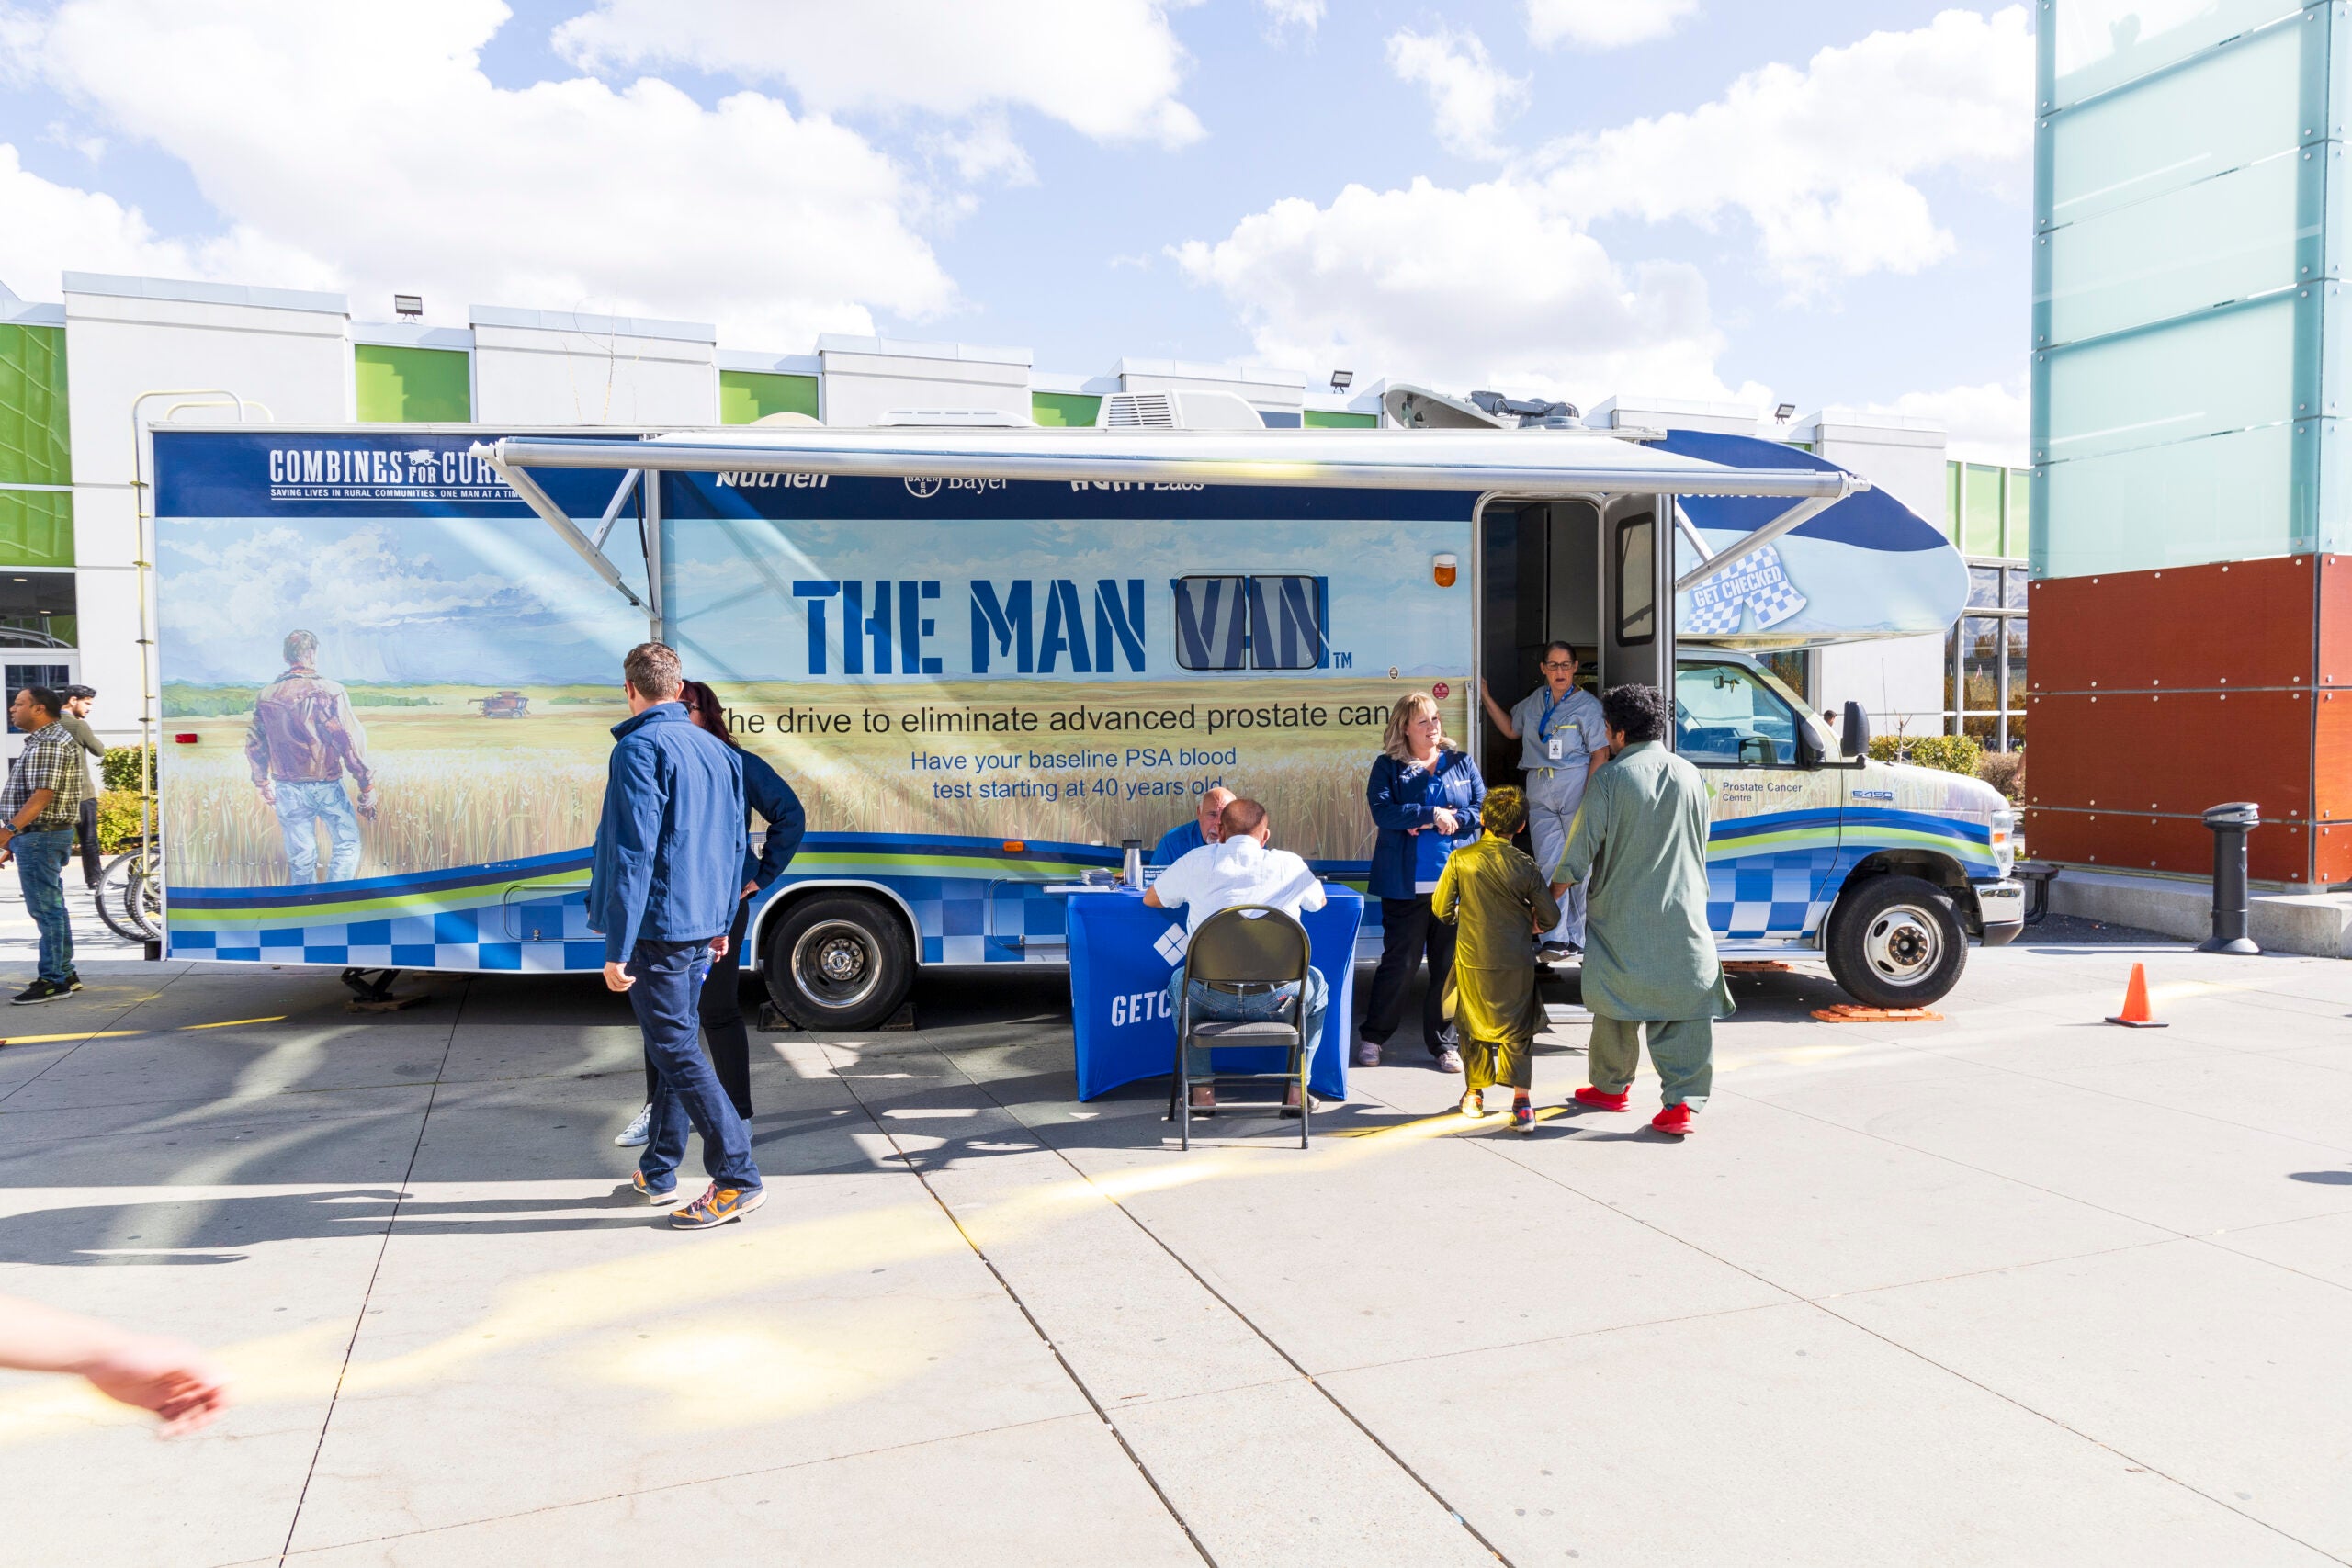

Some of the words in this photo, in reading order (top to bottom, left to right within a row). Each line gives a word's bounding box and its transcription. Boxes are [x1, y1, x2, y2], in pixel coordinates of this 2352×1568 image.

[269, 449, 403, 484] COMBINES
[408, 466, 436, 484] FOR
[442, 451, 508, 484] CUR
[270, 489, 302, 497] SAVING
[305, 489, 329, 497] LIVES
[332, 489, 341, 497] IN
[344, 489, 372, 497] RURAL
[375, 489, 437, 498] COMMUNITIES.
[441, 490, 458, 498] ONE
[460, 490, 479, 498] MAN
[482, 490, 492, 498] AT
[494, 490, 501, 498] A
[1694, 585, 1721, 607] GET
[1722, 565, 1782, 599] CHECKED
[793, 580, 943, 675] THE
[970, 579, 1146, 674] MAN
[1170, 576, 1329, 672] VAN
[1333, 651, 1353, 670] TM
[720, 708, 765, 734] he
[777, 707, 852, 734] drive
[863, 708, 890, 733] to
[901, 705, 1038, 732] eliminate
[1050, 705, 1196, 731] advanced
[1207, 702, 1327, 735] prostate
[911, 751, 967, 770] Have
[975, 754, 1023, 773] your
[1029, 750, 1117, 769] baseline
[1125, 749, 1173, 767] PSA
[1180, 748, 1237, 766] blood
[933, 781, 972, 799] test
[979, 779, 1057, 802] starting
[1066, 780, 1085, 797] at
[1092, 778, 1118, 797] 40
[1126, 780, 1184, 800] years
[1723, 782, 1764, 792] Prostate
[1767, 783, 1803, 793] Cancer
[1723, 794, 1752, 802] Centre
